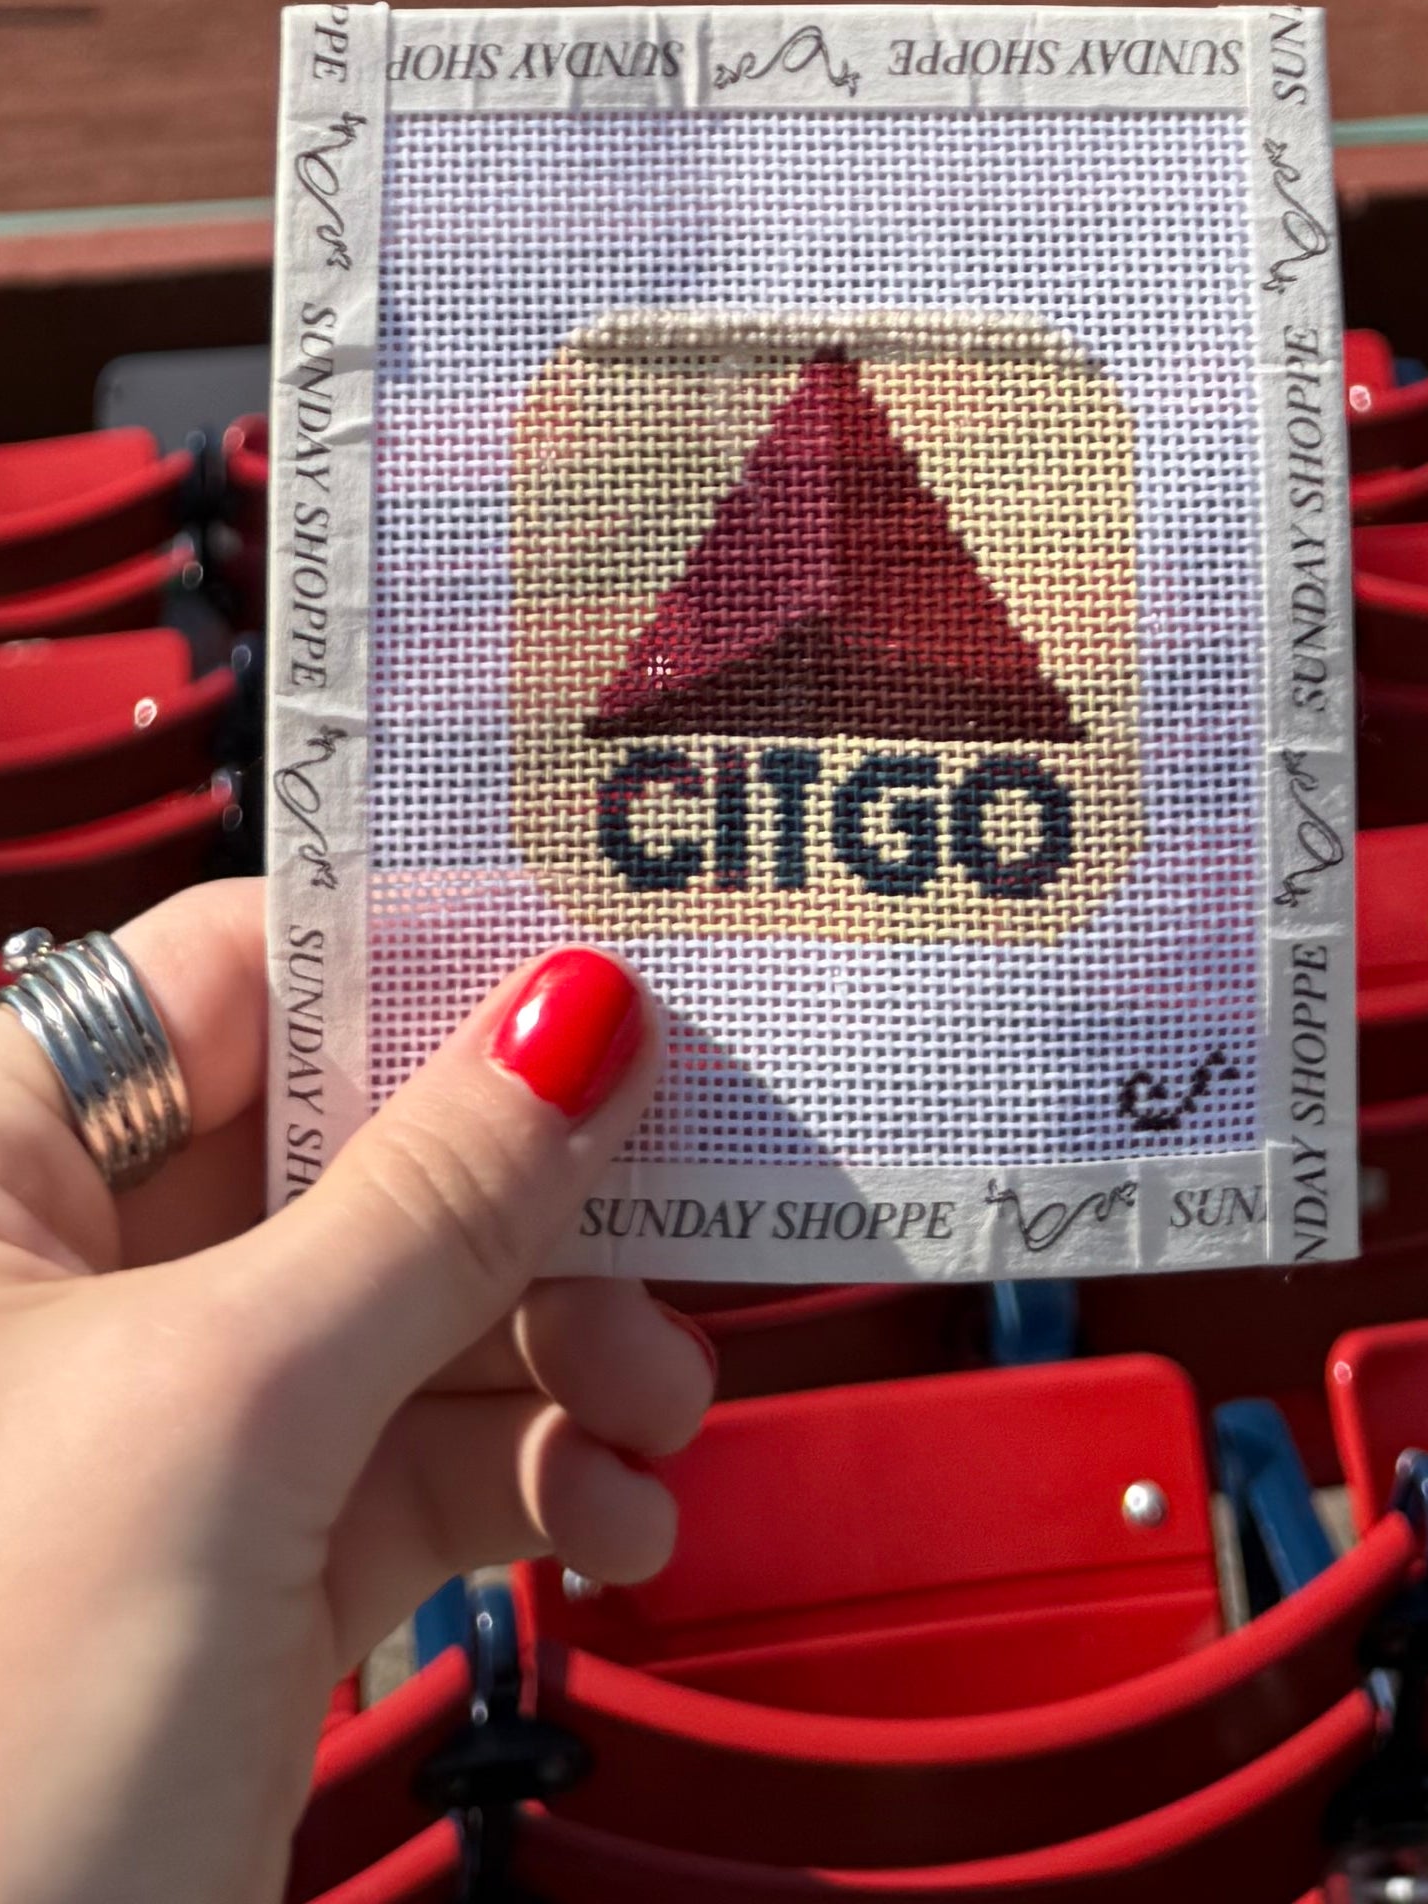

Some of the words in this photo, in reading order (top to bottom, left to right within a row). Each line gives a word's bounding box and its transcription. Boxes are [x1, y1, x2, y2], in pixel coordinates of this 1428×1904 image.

[509, 41, 684, 80] SUNDAY
[887, 38, 1060, 77] SHOPPE
[1067, 38, 1245, 77] SUNDAY
[1269, 7, 1308, 106] SUN
[295, 302, 339, 495] SUNDAY
[1283, 324, 1326, 515] SHOPPE
[291, 501, 331, 690] SHOPPE
[1289, 522, 1329, 712] SUNDAY
[596, 745, 1073, 901] CITGO
[286, 924, 325, 1116] SUNDAY
[1290, 943, 1328, 1126] SHOPPE
[578, 1197, 769, 1241] SUNDAY
[770, 1199, 957, 1242] SHOPPE
[1169, 1184, 1267, 1229] SUN
